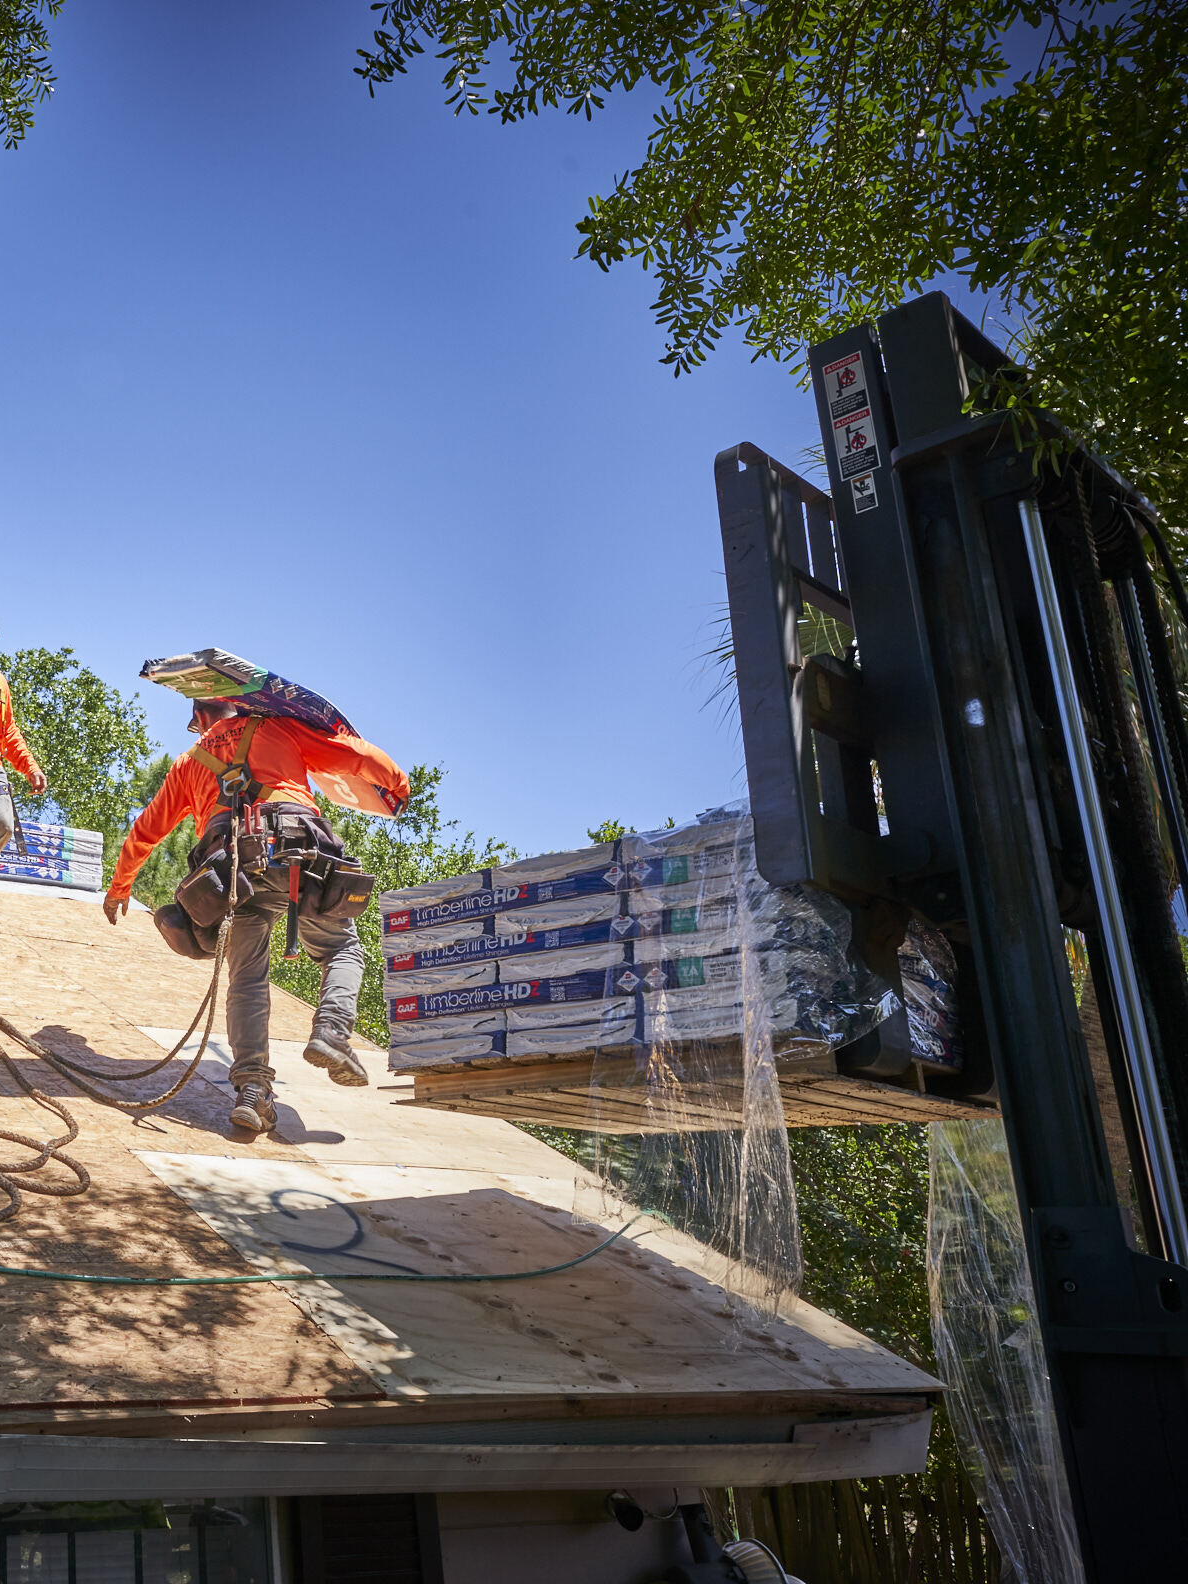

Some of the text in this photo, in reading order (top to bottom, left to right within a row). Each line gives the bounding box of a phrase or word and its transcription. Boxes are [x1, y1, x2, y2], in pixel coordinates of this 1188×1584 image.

[840, 411, 868, 425] DANGER
[415, 884, 529, 920] Timberline HDZ
[390, 915, 409, 926] GAF
[430, 915, 456, 925] Definition
[501, 932, 536, 947] HDZ
[394, 953, 412, 963] GAF
[421, 959, 435, 967] High
[435, 956, 461, 965] Definition
[423, 981, 540, 1010] Timberline HDZ
[397, 1002, 416, 1013] GAF
[438, 1007, 465, 1015] Definition
